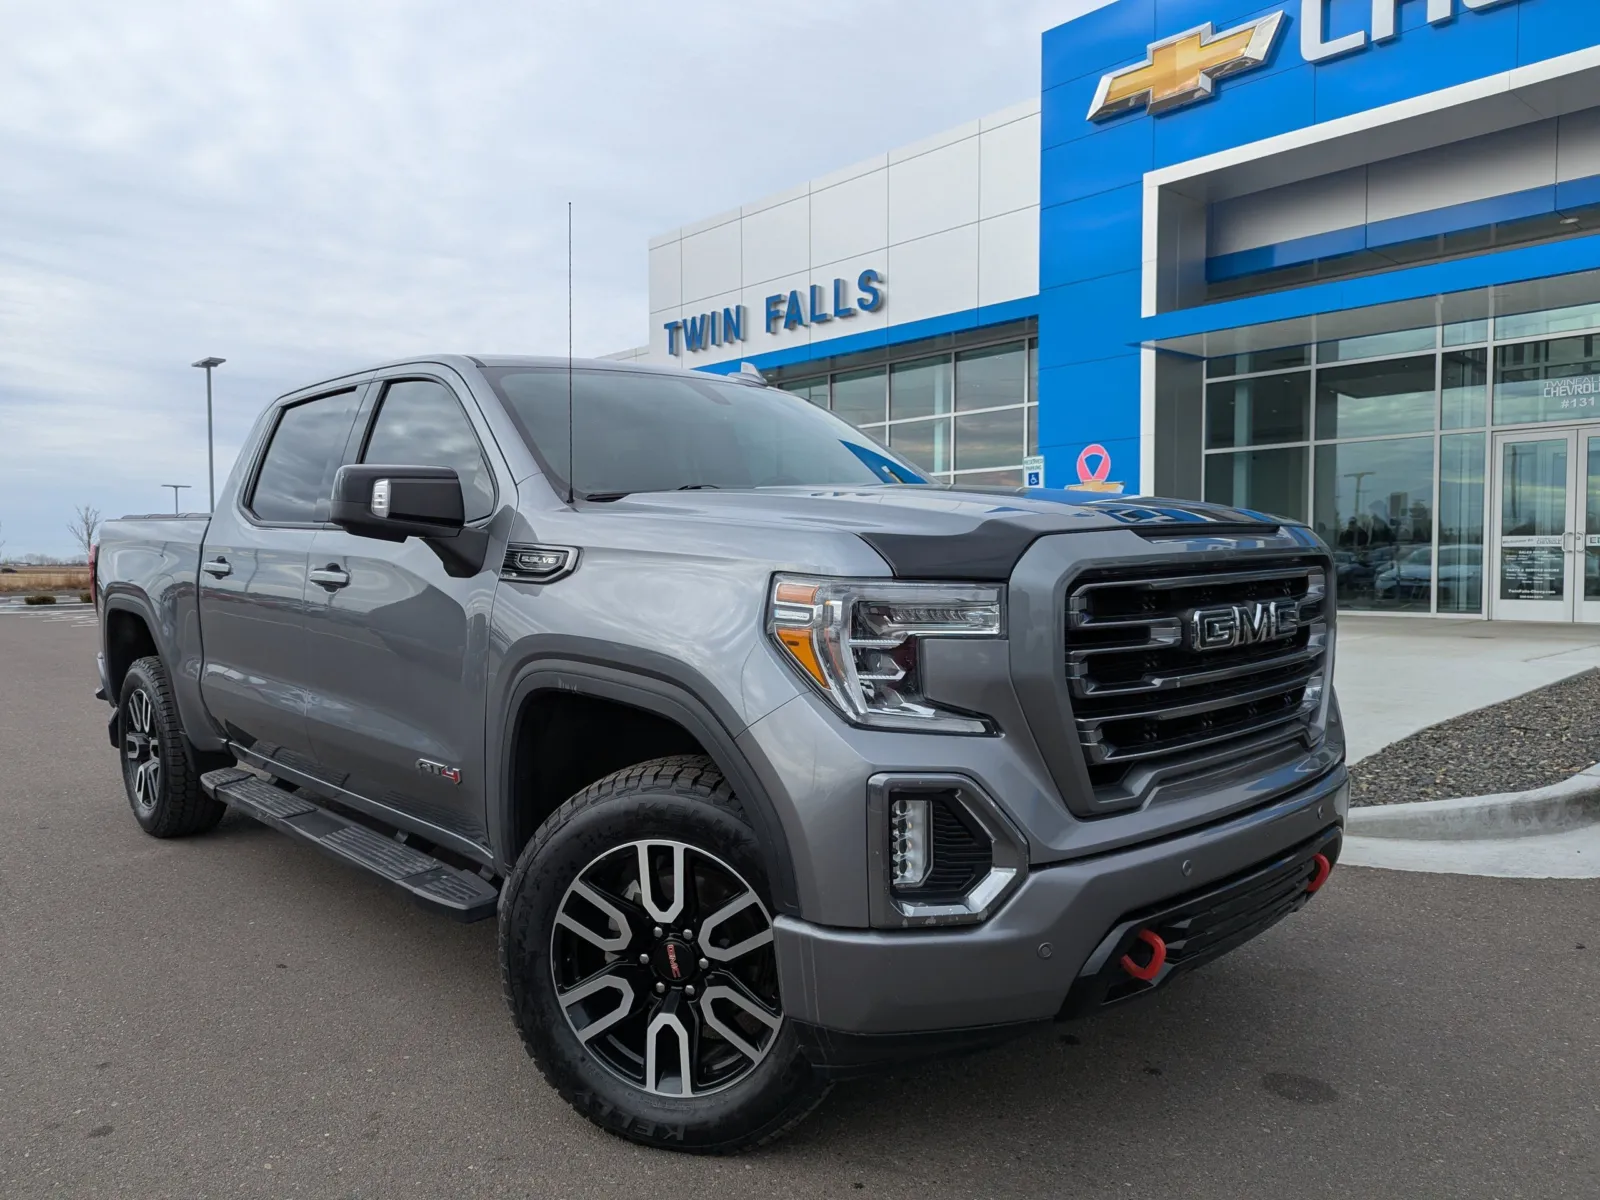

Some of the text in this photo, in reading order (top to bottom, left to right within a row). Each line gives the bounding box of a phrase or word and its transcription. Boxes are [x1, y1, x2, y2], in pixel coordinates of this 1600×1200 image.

[664, 269, 884, 356] TWIN FALLS
[1543, 382, 1600, 398] CHEVROL
[1560, 396, 1595, 409] #131
[1192, 602, 1298, 651] GMC
[415, 758, 462, 785] AT4
[667, 944, 681, 978] GMC
